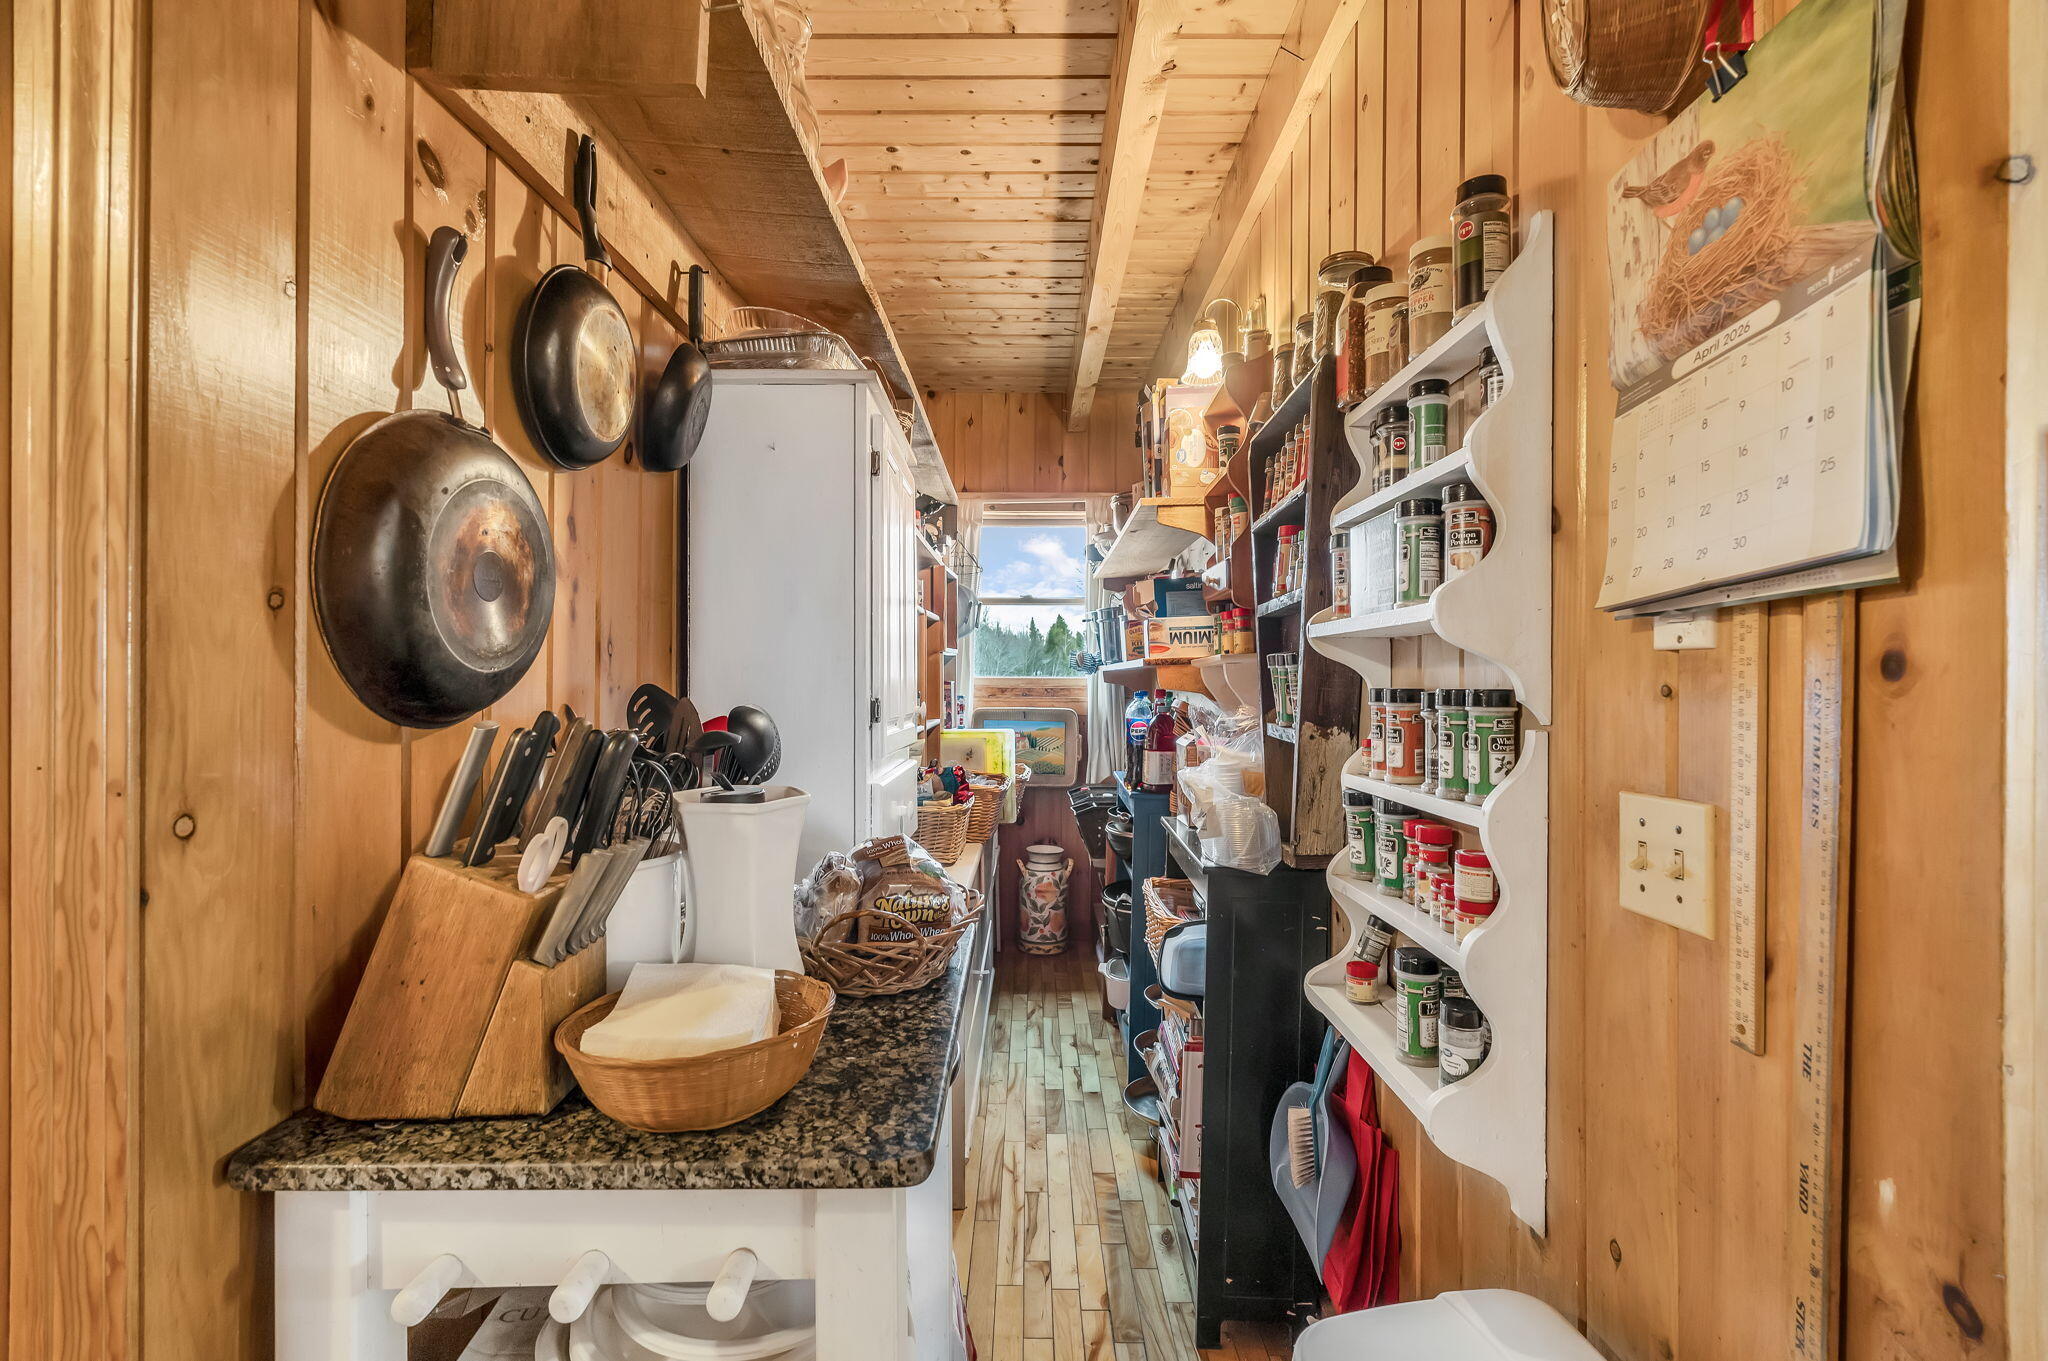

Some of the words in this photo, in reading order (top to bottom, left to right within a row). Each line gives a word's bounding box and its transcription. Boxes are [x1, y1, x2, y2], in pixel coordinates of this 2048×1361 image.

[1693, 339, 1720, 364] April
[1723, 320, 1751, 346] 2026
[1741, 354, 1747, 367] 2
[1783, 331, 1791, 345] 3
[1826, 305, 1834, 318] 4
[1611, 463, 1617, 473] 5
[1638, 449, 1644, 460] 6
[1668, 434, 1674, 446] 7
[1702, 418, 1708, 430] 8
[1738, 400, 1746, 413] 9
[1781, 377, 1794, 392] 10
[1825, 355, 1834, 370] 11
[1611, 499, 1618, 510] 12
[1638, 487, 1646, 499] 13
[1667, 474, 1676, 487] 14
[1700, 460, 1711, 473] 15
[1738, 444, 1749, 458] 16
[1779, 426, 1789, 441] 17
[1823, 406, 1835, 422] 18
[1610, 537, 1618, 548] 19
[1636, 526, 1648, 539] 20
[1666, 516, 1675, 528] 21
[1699, 503, 1712, 517] 22
[1736, 489, 1749, 504] 23
[1776, 474, 1790, 490] 24
[1819, 456, 1836, 474] 25
[1450, 539, 1478, 547] Powder
[1451, 532, 1476, 540] Onion
[1604, 574, 1614, 586] 26
[1632, 566, 1642, 578] 27
[1662, 557, 1674, 570] 28
[1696, 547, 1709, 561] 29
[1732, 535, 1748, 550] 30
[1169, 630, 1213, 645] MIUM
[1811, 678, 1822, 829] CENTIMETERS
[870, 932, 890, 941] 100%
[1802, 1043, 1812, 1082] THE
[1799, 1162, 1810, 1214] YARD
[1795, 1297, 1806, 1357] STICK
